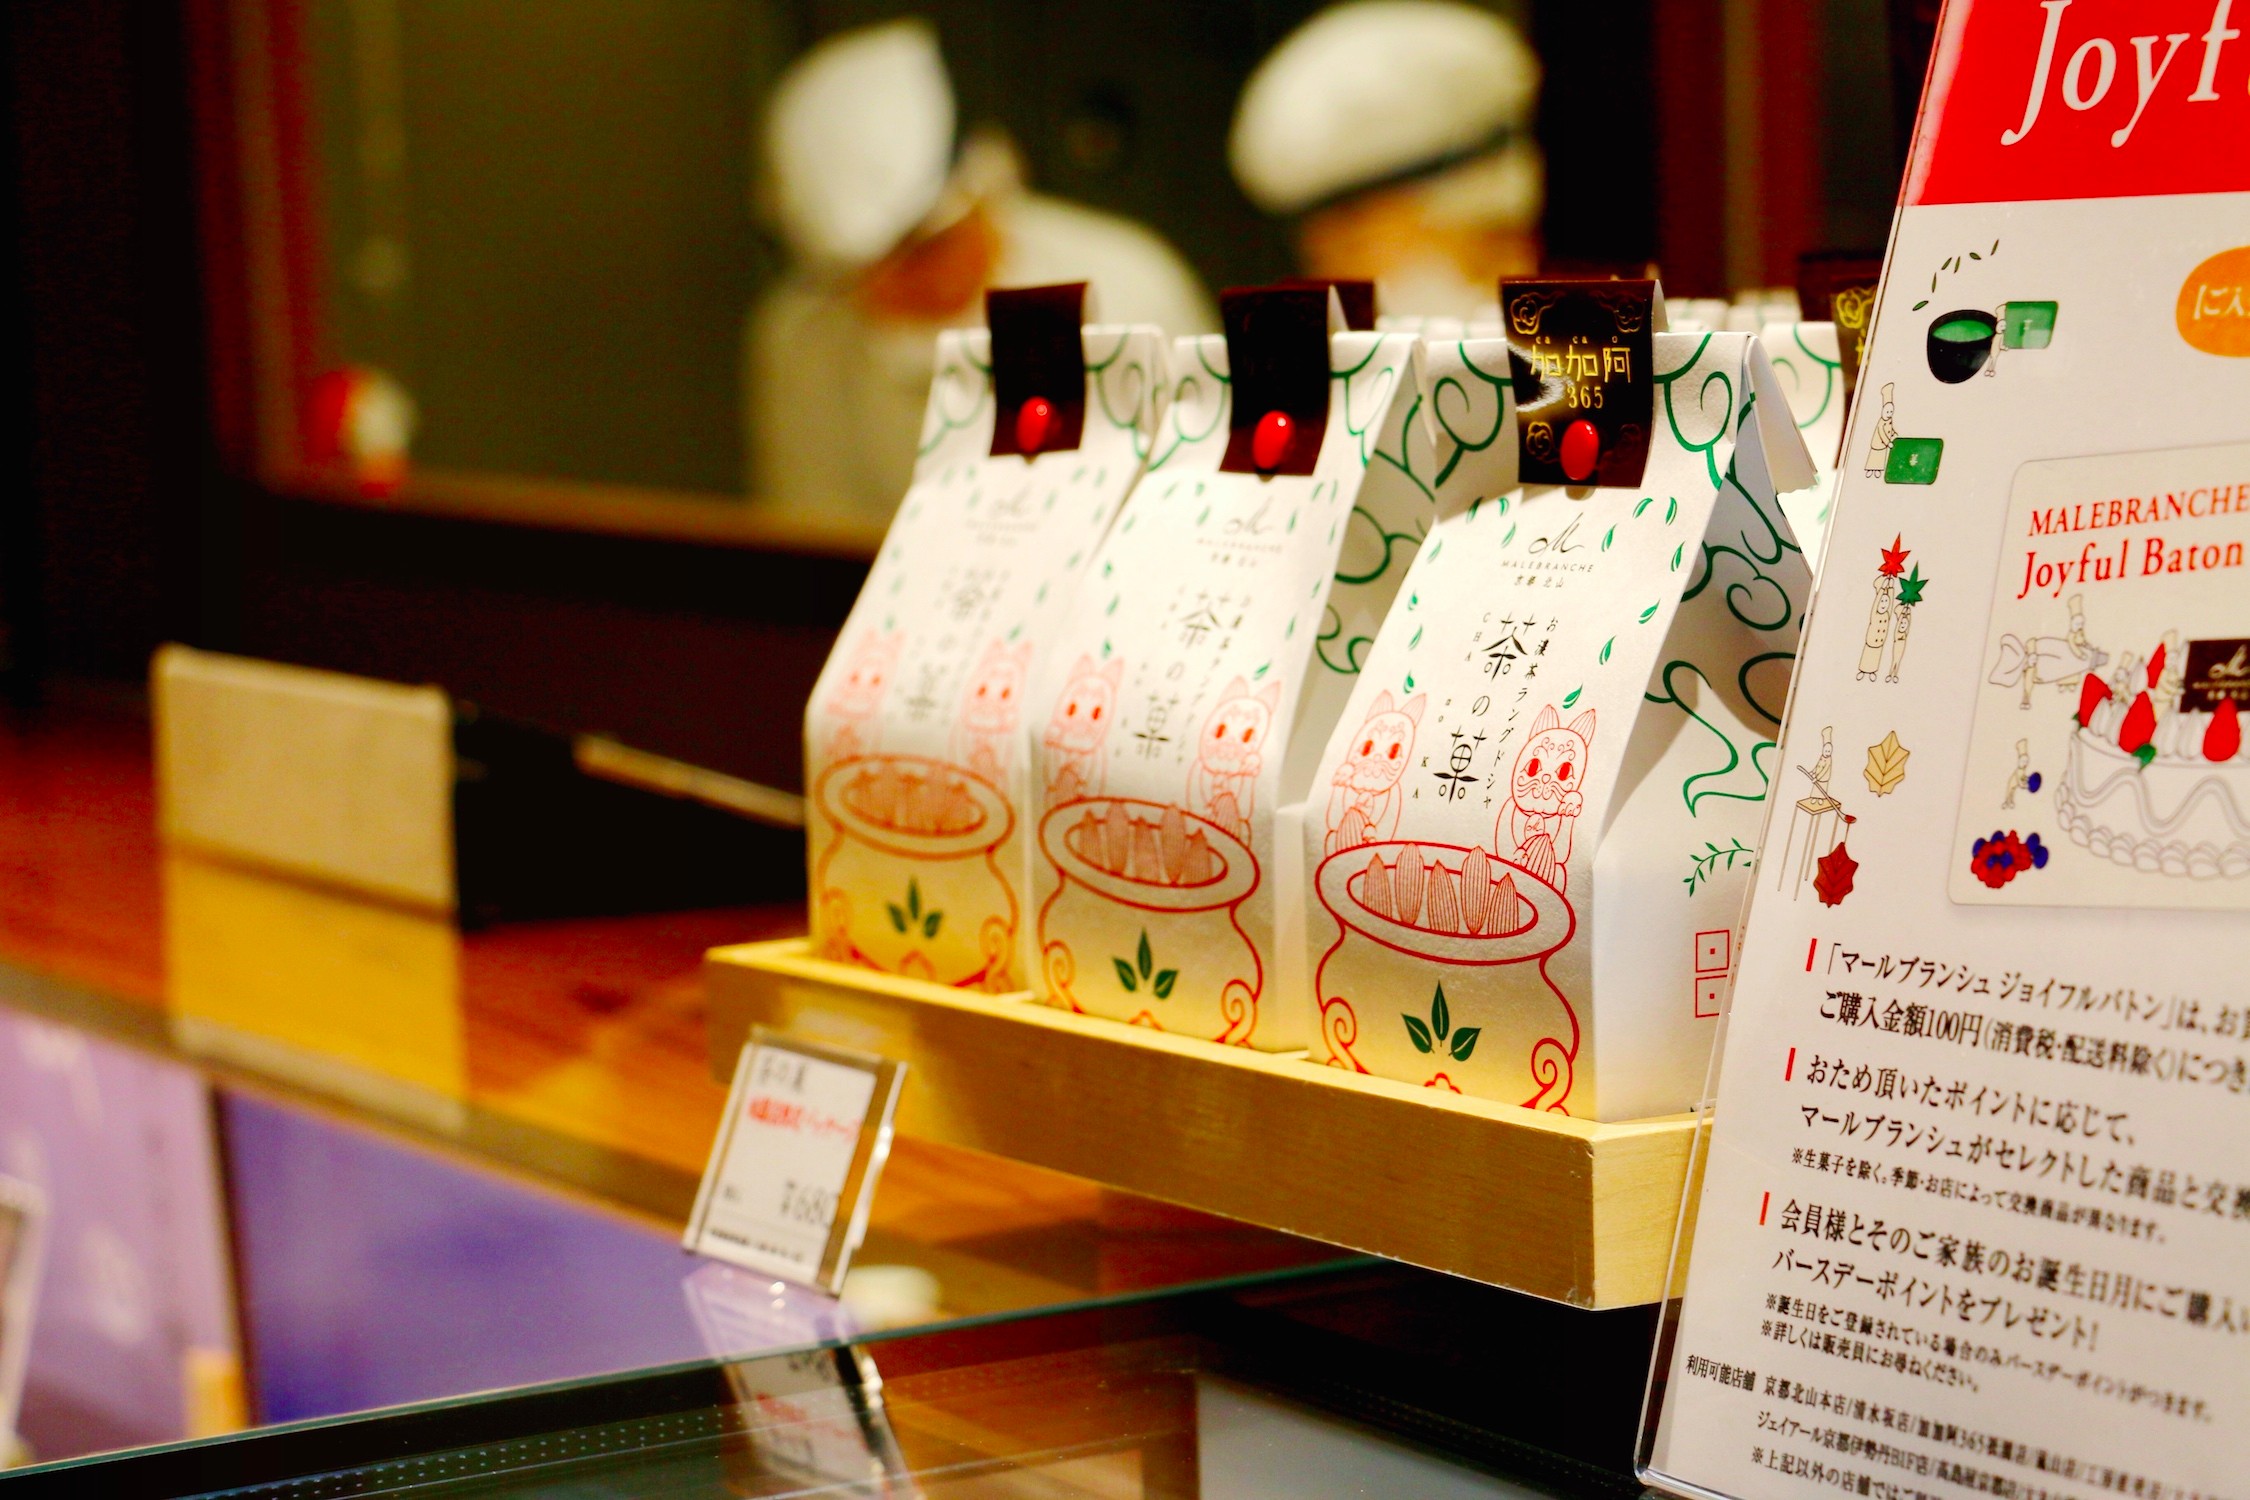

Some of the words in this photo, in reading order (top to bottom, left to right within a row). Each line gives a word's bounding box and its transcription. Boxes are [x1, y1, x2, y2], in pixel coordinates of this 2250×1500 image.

[2000, 0, 2250, 148] Joyf
[1529, 344, 1631, 383] 加加阿
[1567, 386, 1604, 409] 365
[2027, 483, 2250, 537] MALEBRANCHE
[1501, 559, 1594, 573] MALEBRANCHE
[2017, 538, 2129, 600] Joyful
[2140, 537, 2244, 577] Baton
[1432, 611, 1538, 806] 茶の菓
[1684, 1354, 1757, 1392] 利用可能店舗
